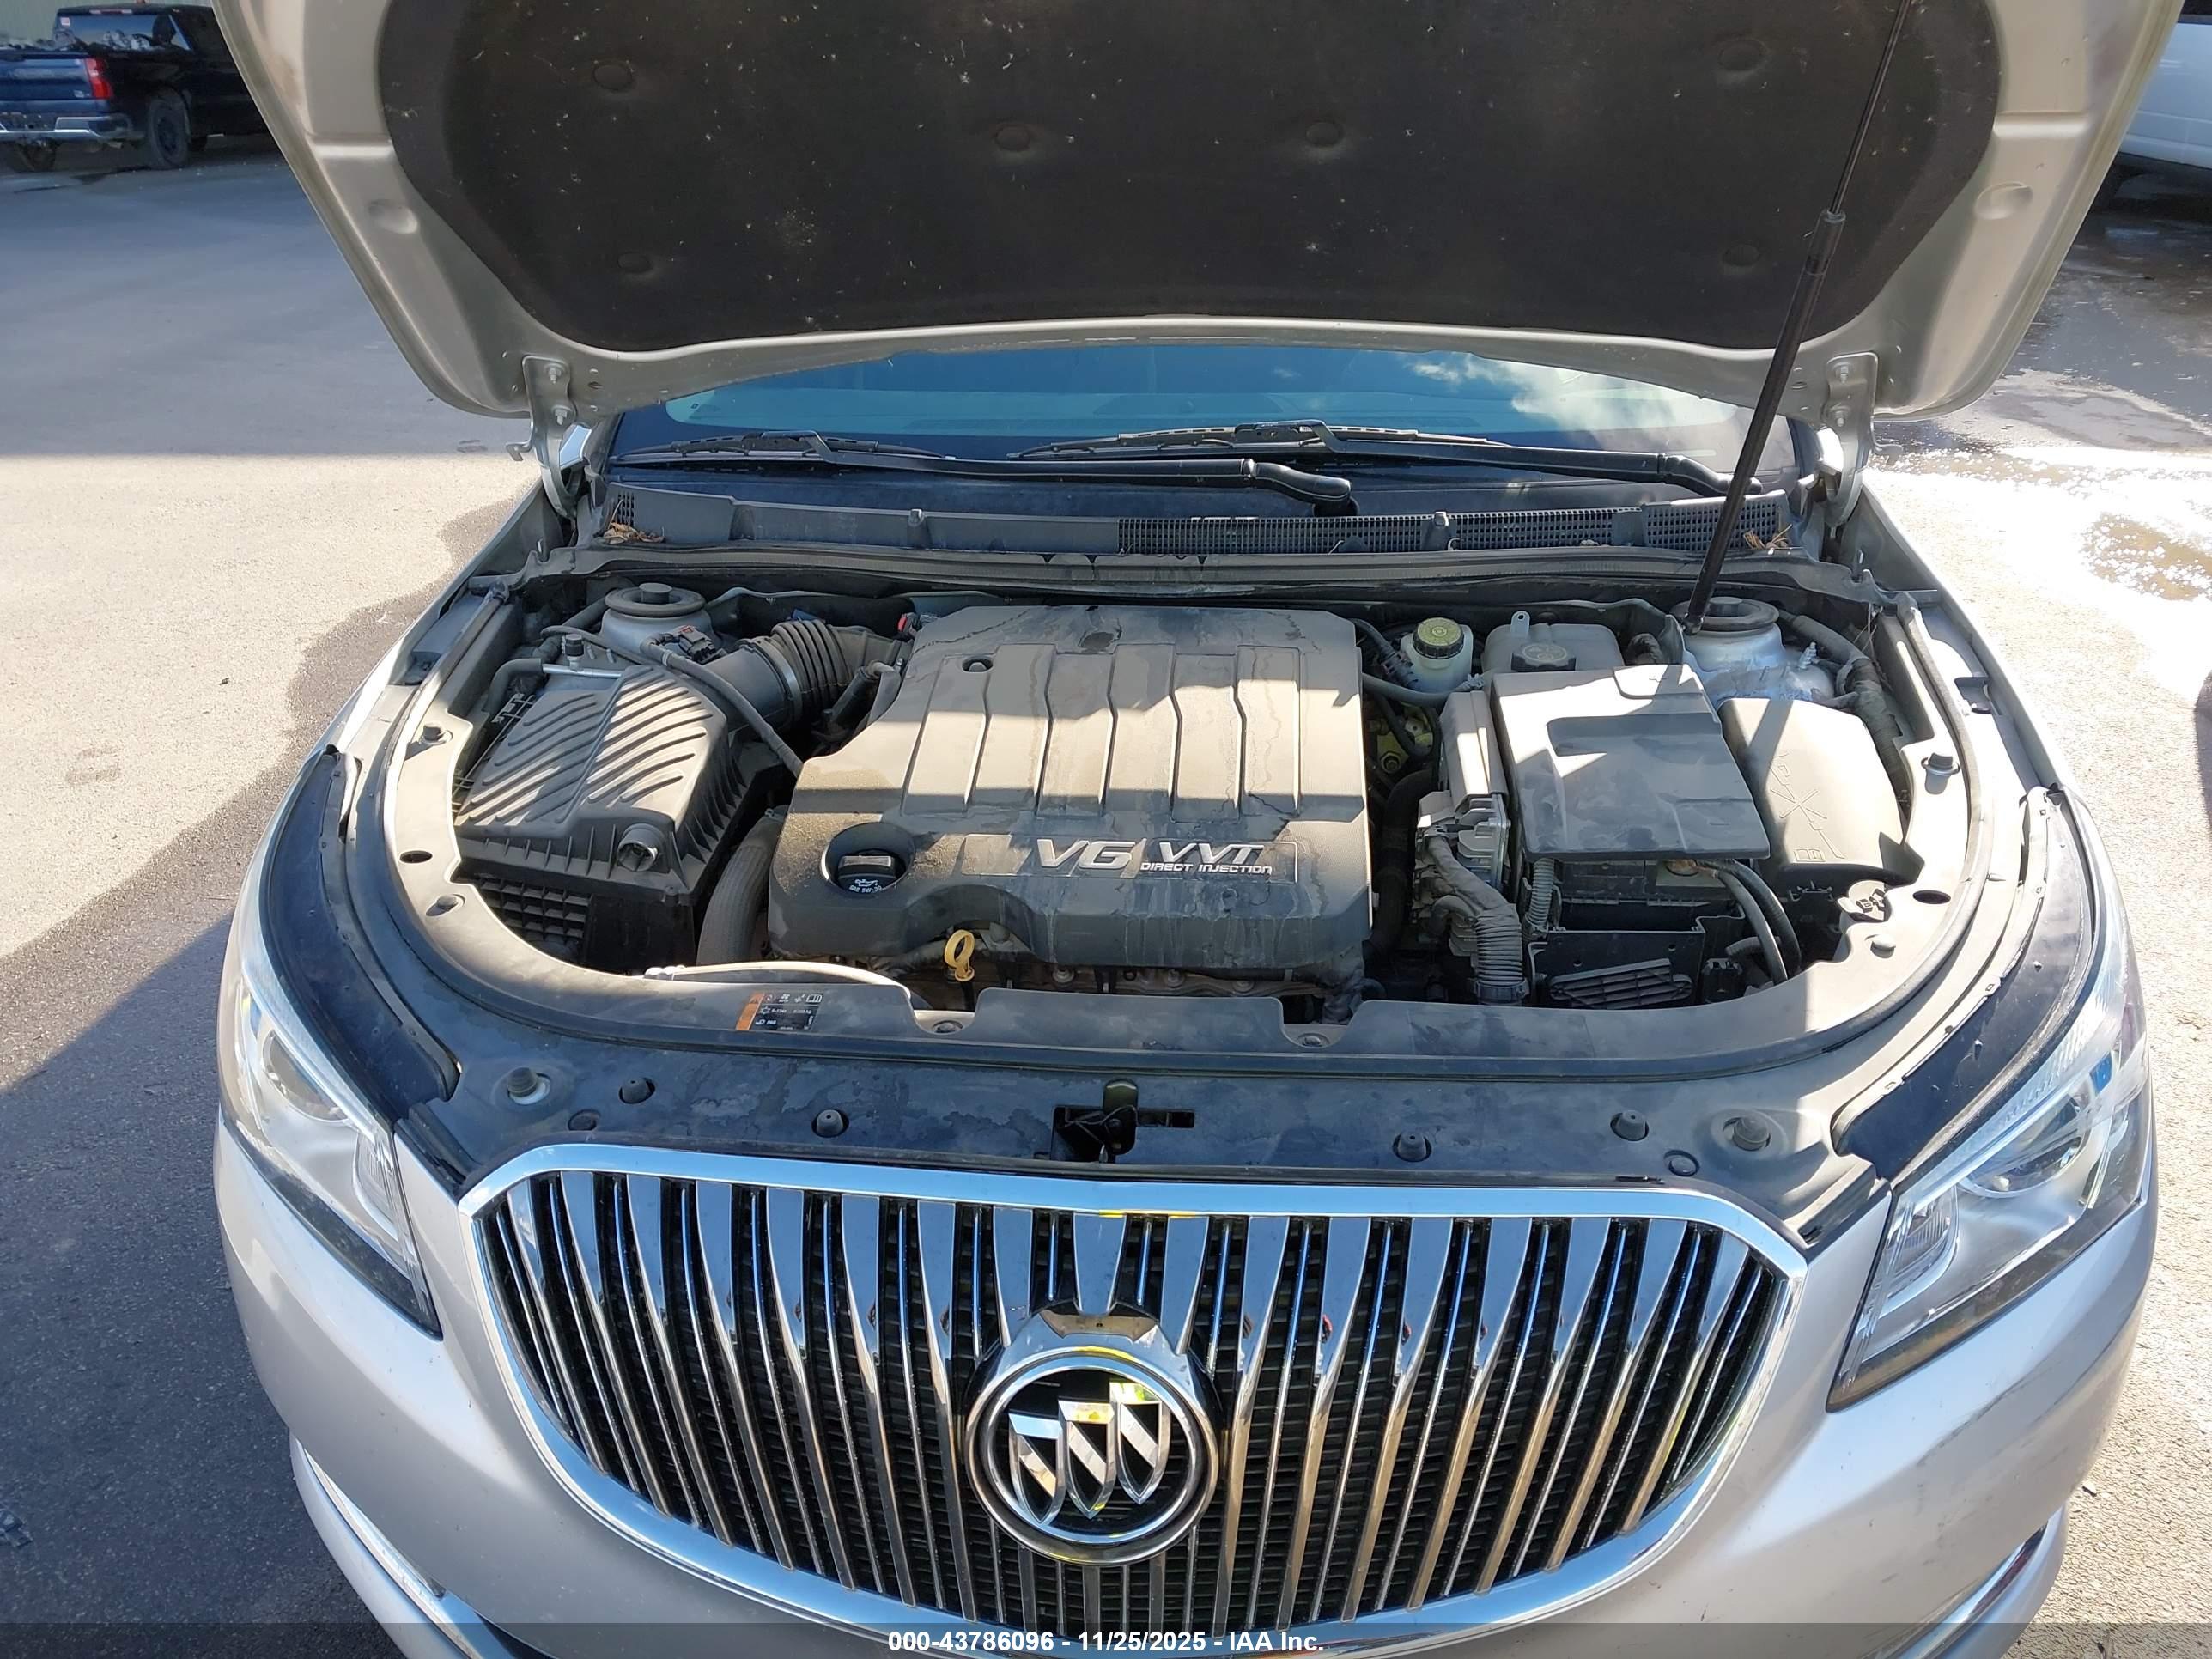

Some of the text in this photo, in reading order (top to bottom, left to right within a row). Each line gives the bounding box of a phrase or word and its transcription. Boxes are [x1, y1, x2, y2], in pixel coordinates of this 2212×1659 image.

[1158, 842, 1264, 865] VVT
[1139, 861, 1273, 875] DIRECT INJECTION
